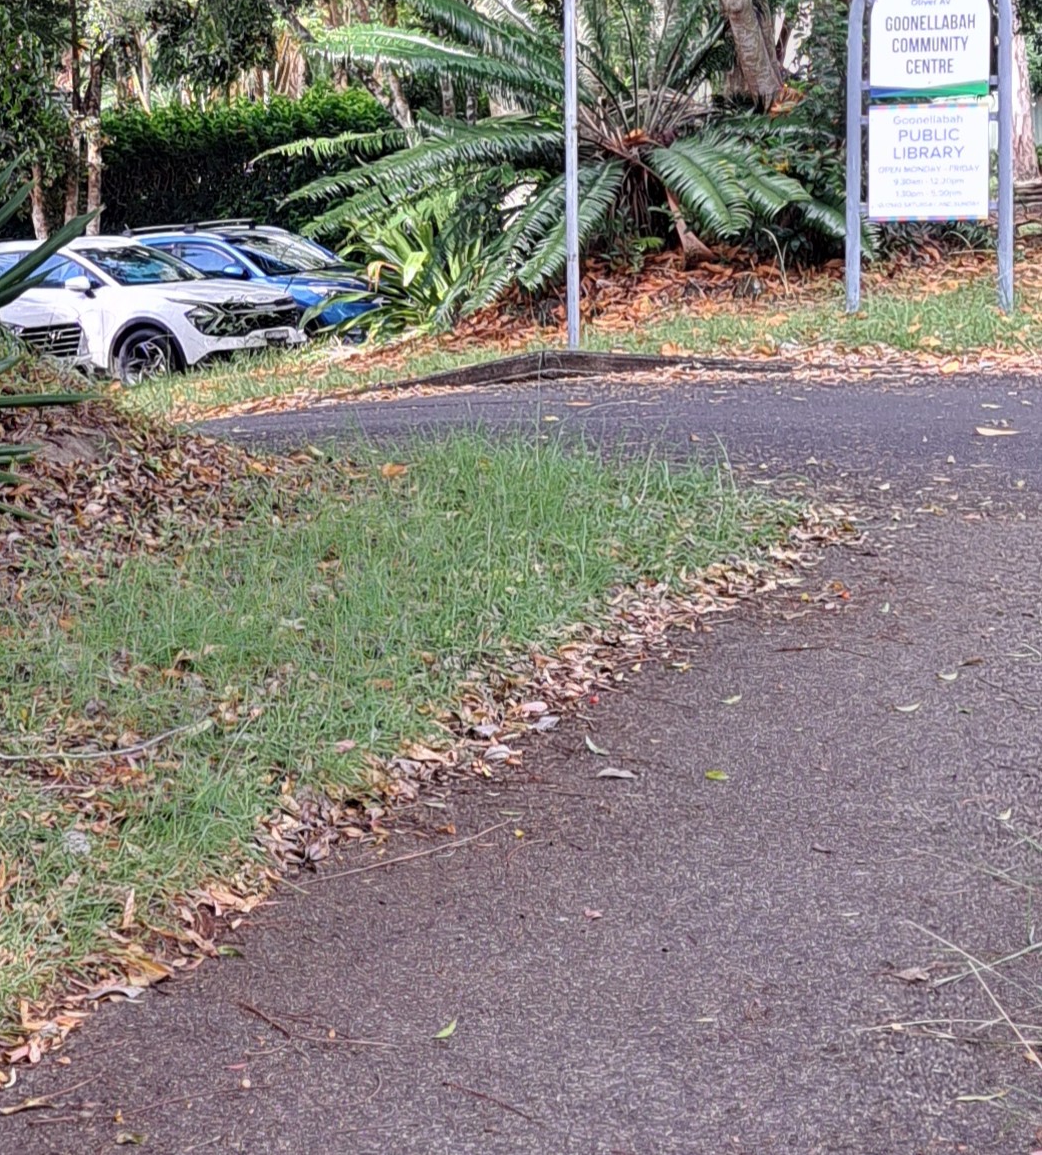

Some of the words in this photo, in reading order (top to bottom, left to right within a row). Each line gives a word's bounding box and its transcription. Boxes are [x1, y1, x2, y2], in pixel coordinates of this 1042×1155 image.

[885, 13, 976, 32] GOONELLABAH
[892, 35, 968, 53] COMMUNITY
[906, 57, 954, 74] CENTRE
[893, 115, 963, 125] Goonellabah
[898, 128, 960, 142] PUBLIC
[893, 145, 965, 160] LIBRARY
[878, 166, 901, 174] OPEN
[904, 165, 941, 174] MONDAY
[949, 164, 980, 173] FRIDAY
